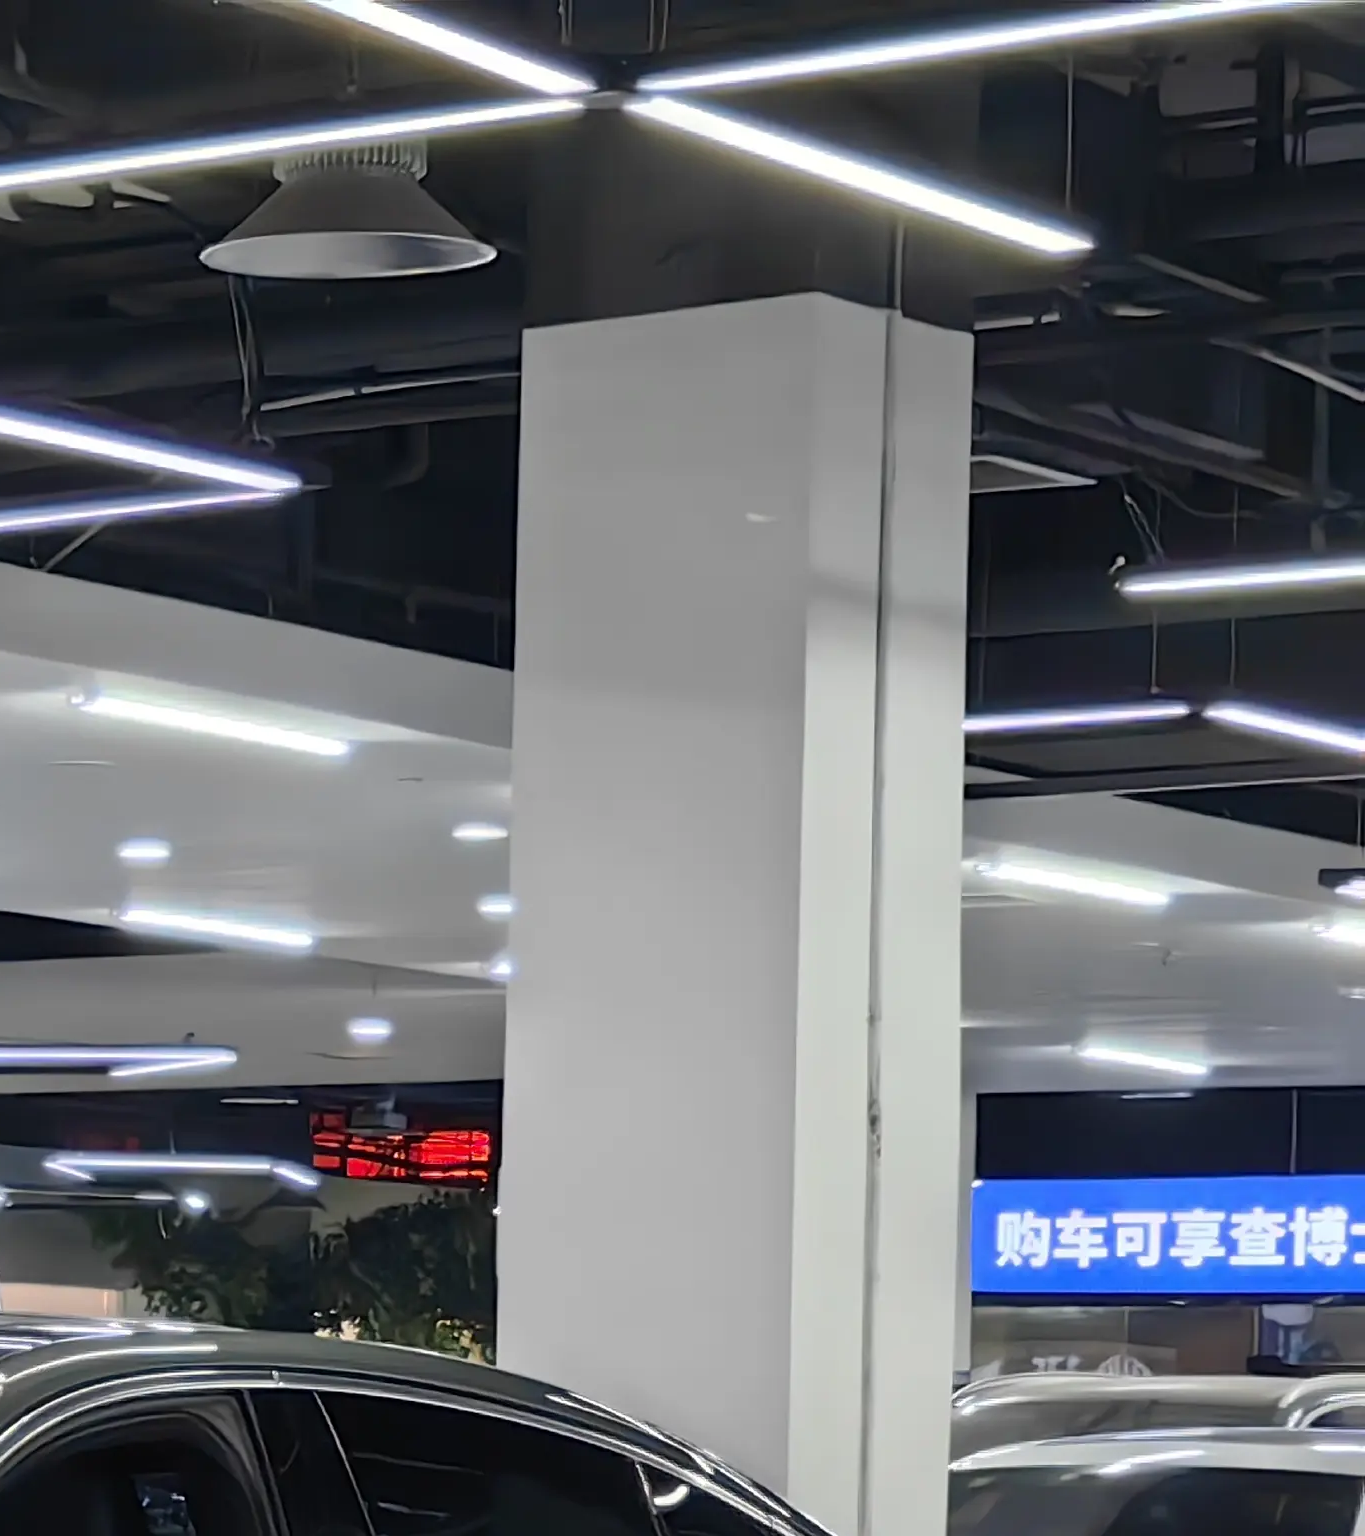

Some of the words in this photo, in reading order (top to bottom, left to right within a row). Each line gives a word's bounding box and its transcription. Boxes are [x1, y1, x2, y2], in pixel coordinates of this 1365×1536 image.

[995, 1206, 1365, 1269] 购车可享查博
